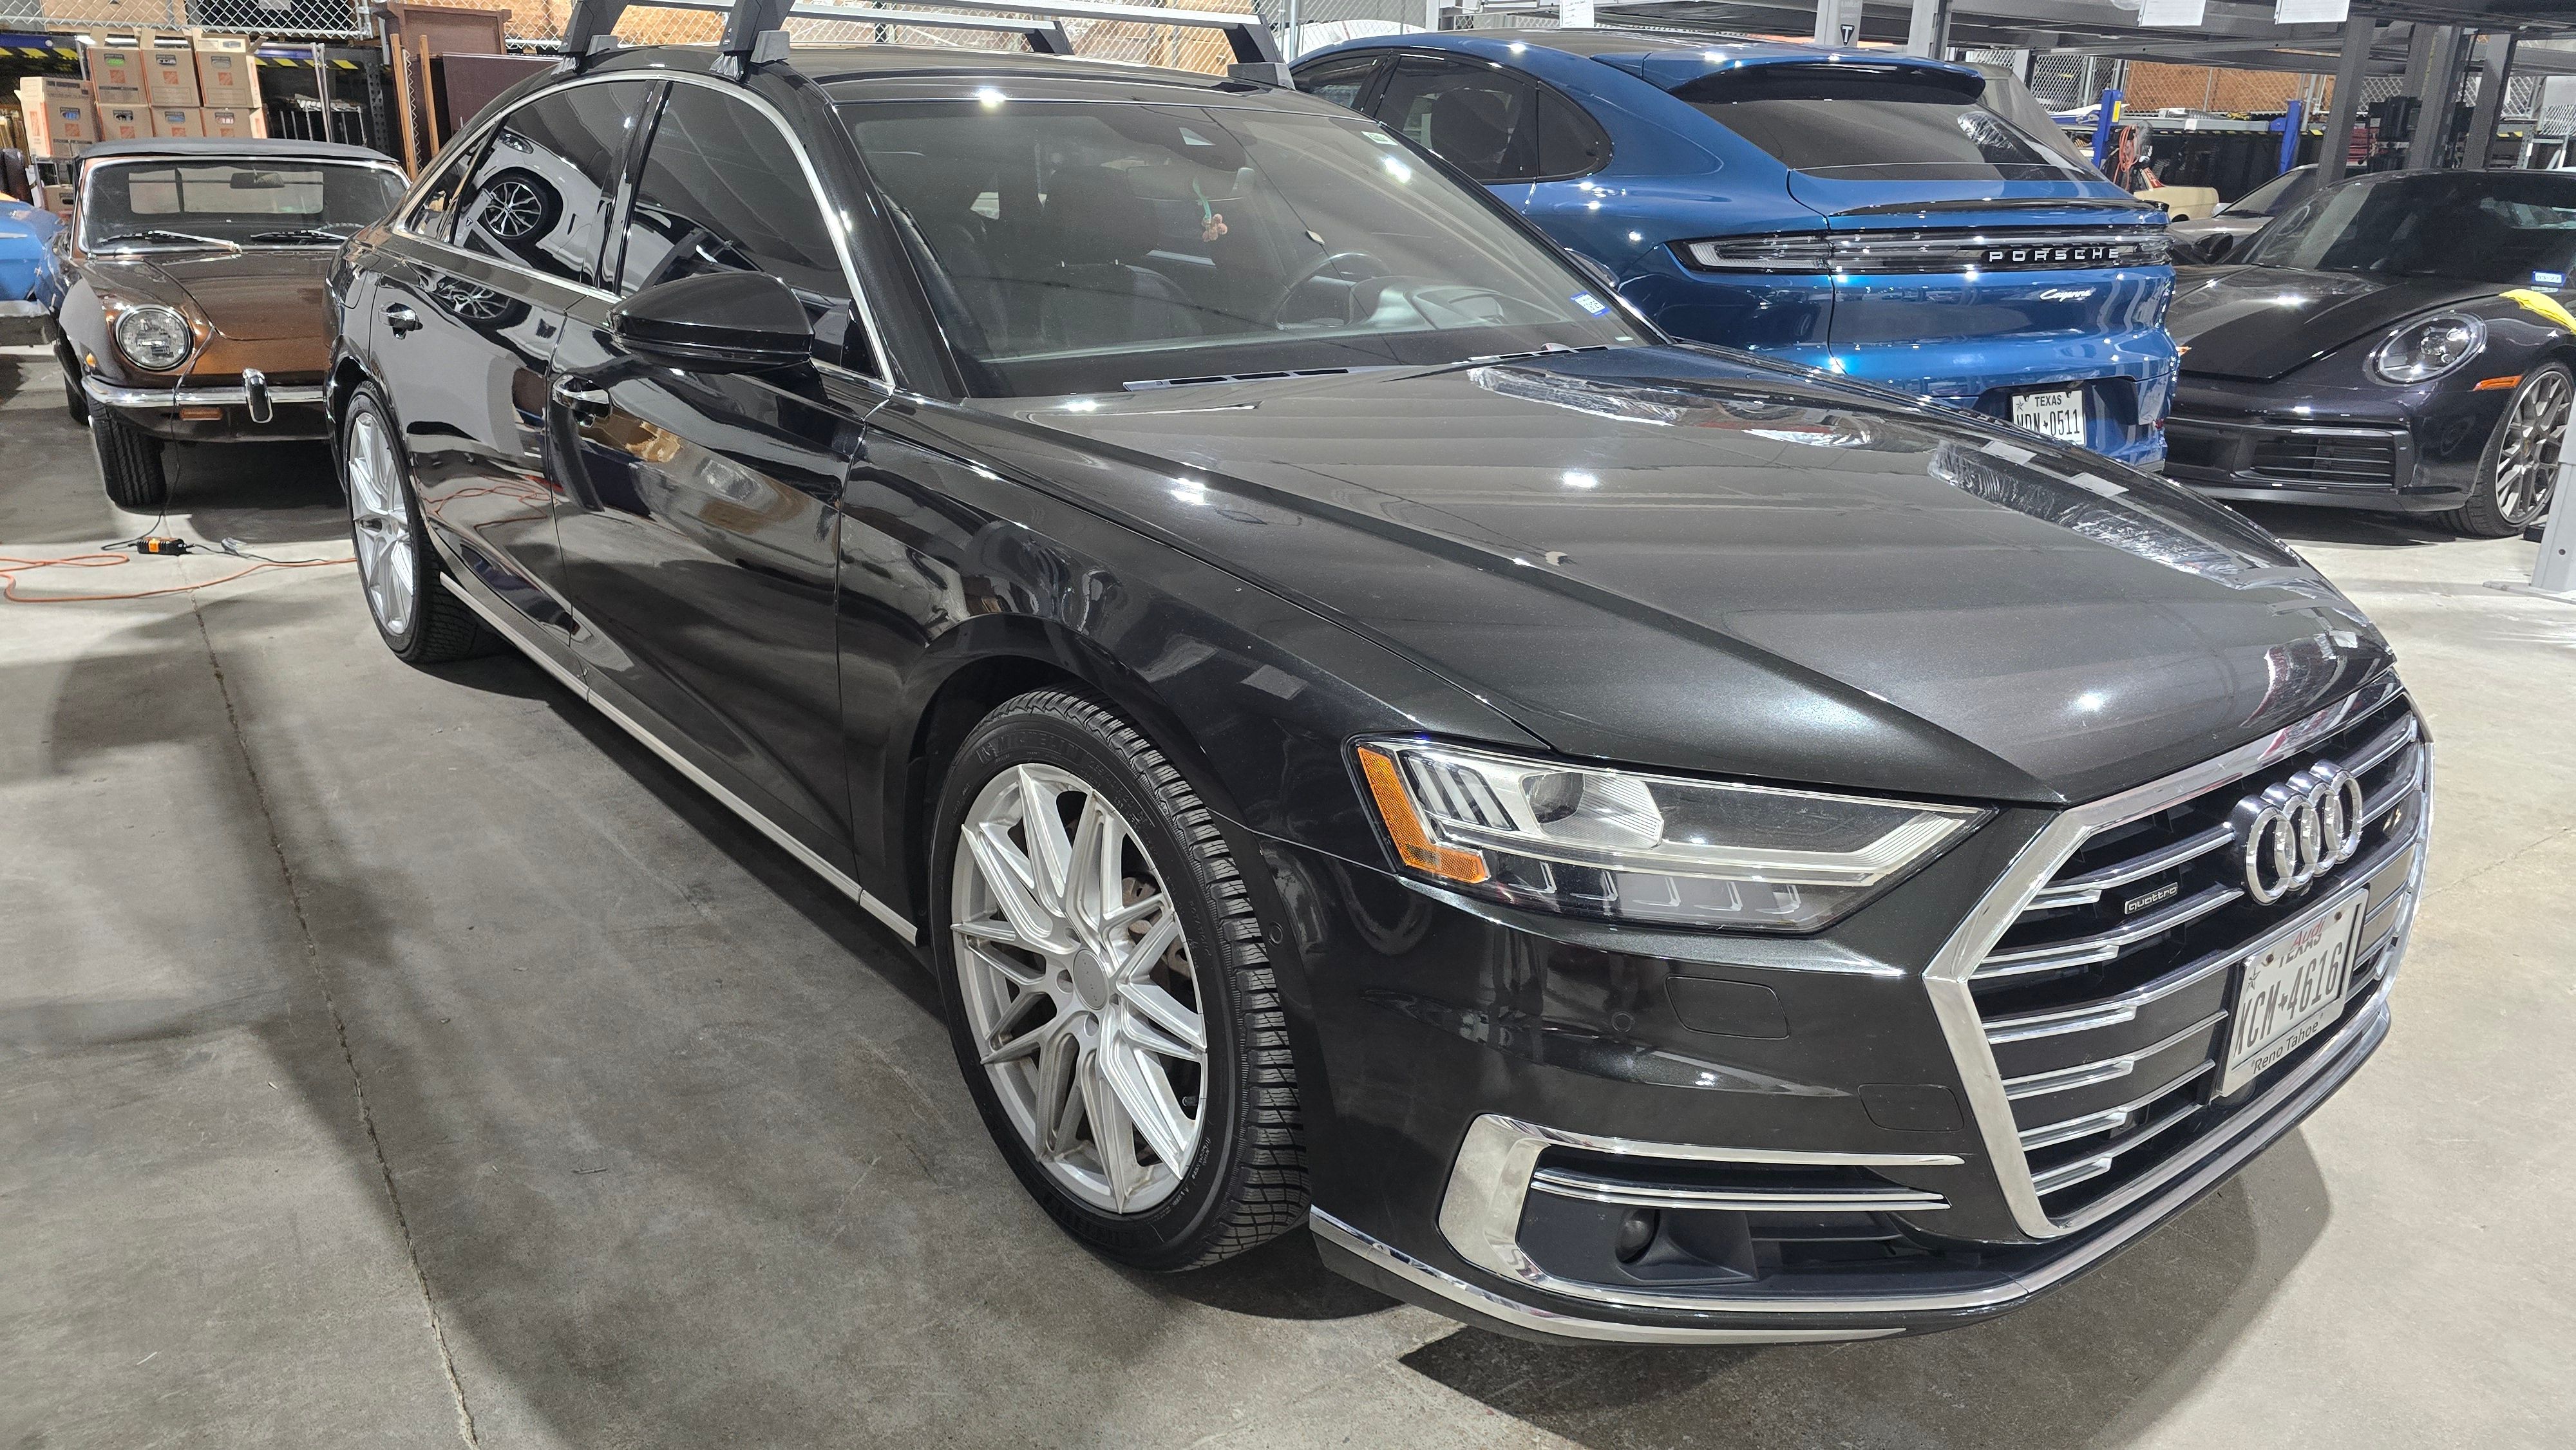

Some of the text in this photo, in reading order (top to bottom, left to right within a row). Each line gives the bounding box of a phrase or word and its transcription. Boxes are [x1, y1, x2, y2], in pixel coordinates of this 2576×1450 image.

[1989, 248, 2119, 262] PORSCHE
[2040, 287, 2095, 302] Cayenne
[2034, 394, 2062, 408] TEXAS
[2049, 408, 2080, 437] 0511
[2128, 887, 2178, 912] quattro
[2289, 915, 2327, 952] Audi
[2286, 941, 2343, 1021] 4616
[2252, 1021, 2319, 1075] Reno Tahoe
